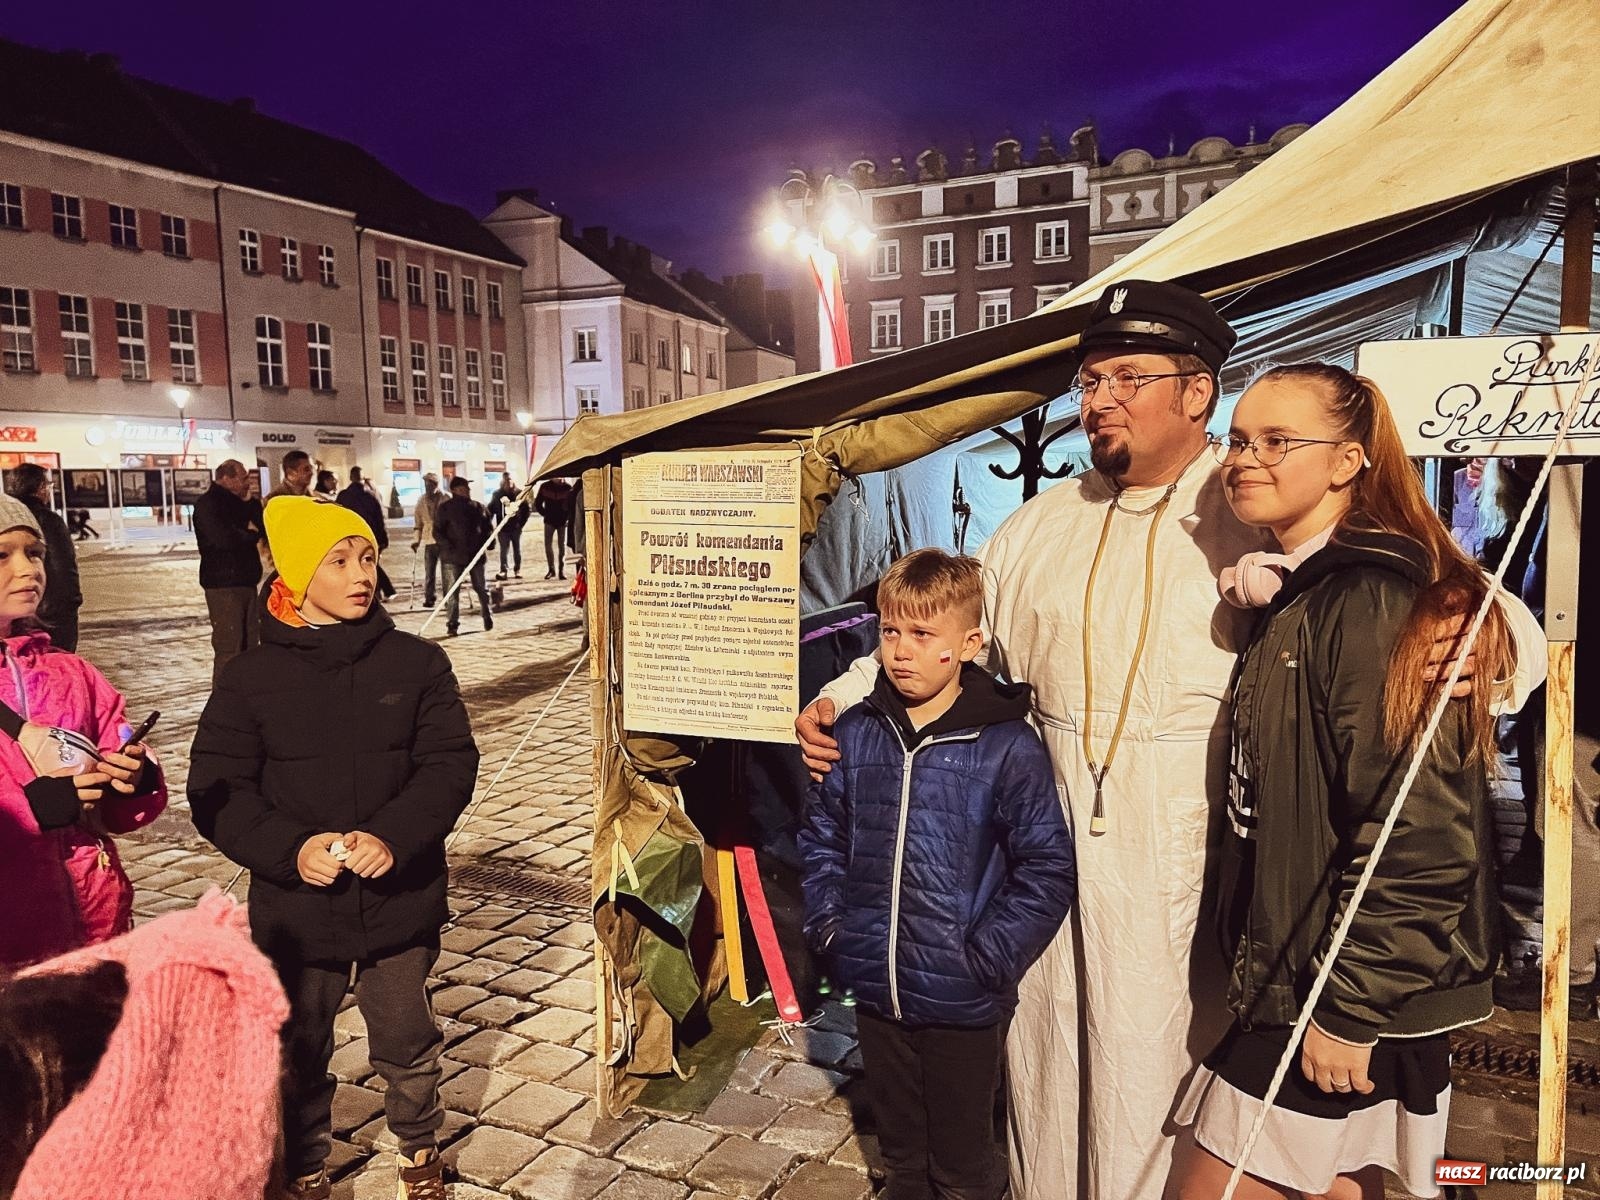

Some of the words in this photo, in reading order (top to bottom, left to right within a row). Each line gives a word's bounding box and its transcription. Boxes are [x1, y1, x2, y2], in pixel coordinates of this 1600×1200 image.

[262, 433, 297, 443] BOLKO
[699, 464, 763, 483] WARSZAWSKI
[640, 530, 689, 548] Powrót
[696, 532, 784, 551] komendanta
[650, 553, 771, 581] Piłsudskiego
[661, 580, 683, 589] godz.
[676, 591, 704, 599] Berlina
[739, 594, 750, 602] do
[751, 594, 796, 605] Warszawy
